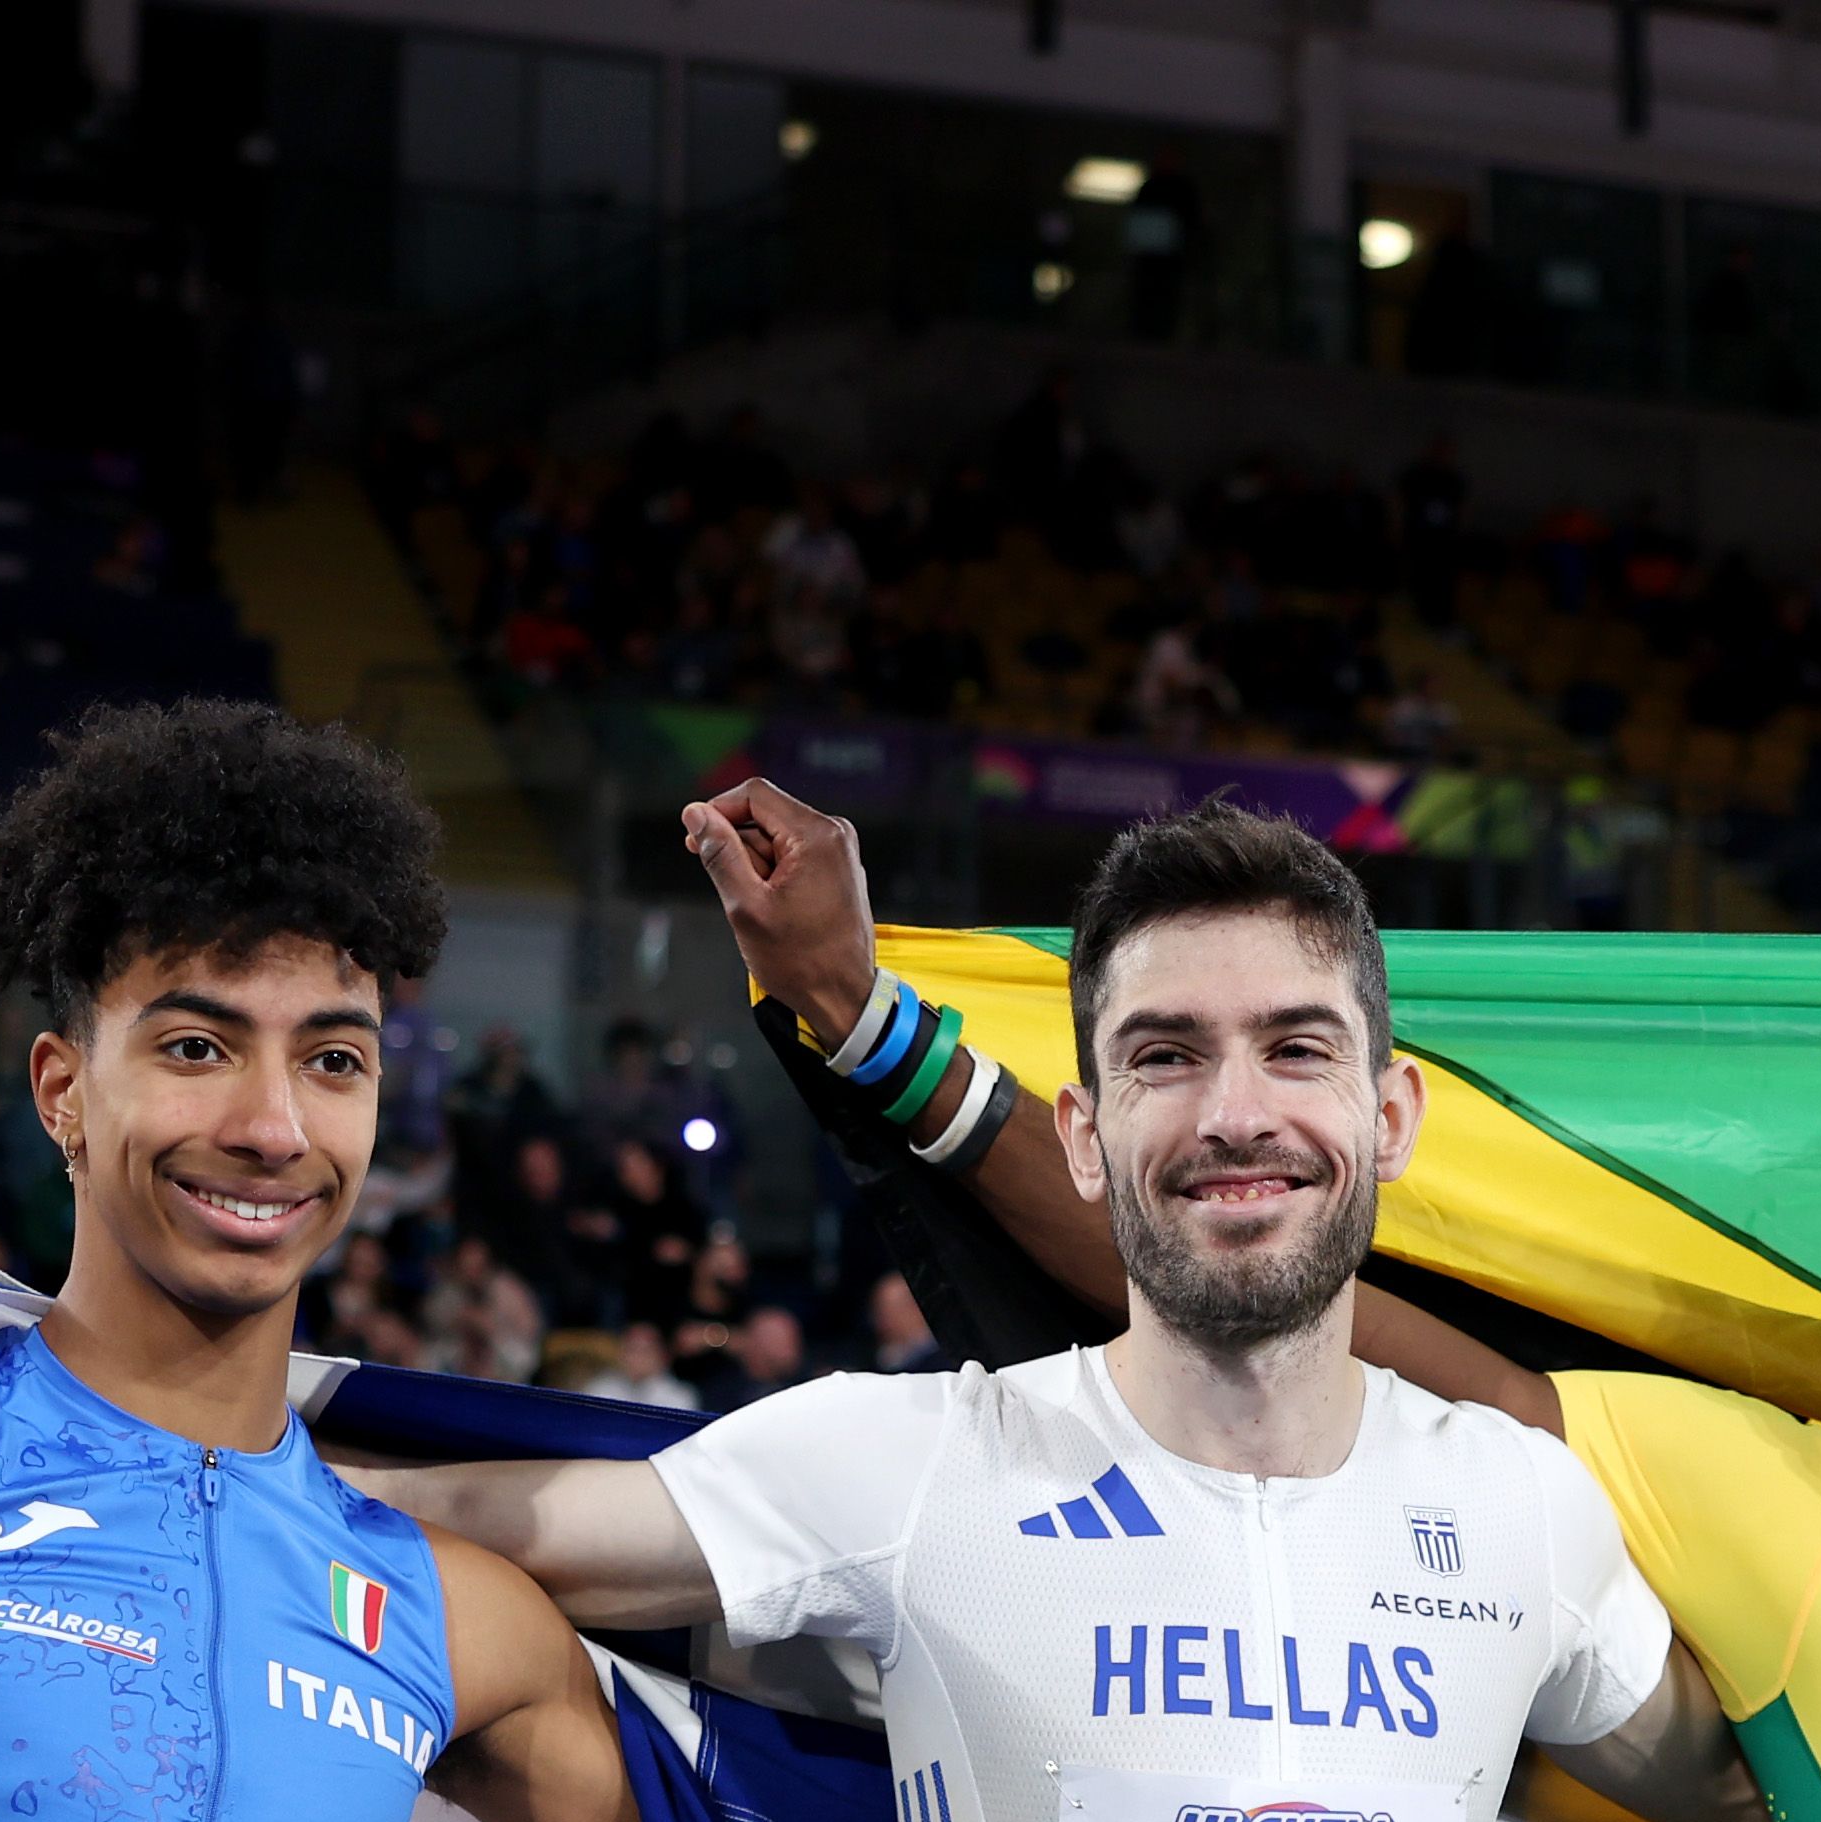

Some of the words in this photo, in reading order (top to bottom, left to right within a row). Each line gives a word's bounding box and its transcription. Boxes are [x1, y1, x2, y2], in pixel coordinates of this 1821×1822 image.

[1370, 1591, 1499, 1623] AEGEAN
[268, 1660, 436, 1778] ITALIA
[1092, 1624, 1439, 1739] HELLAS
